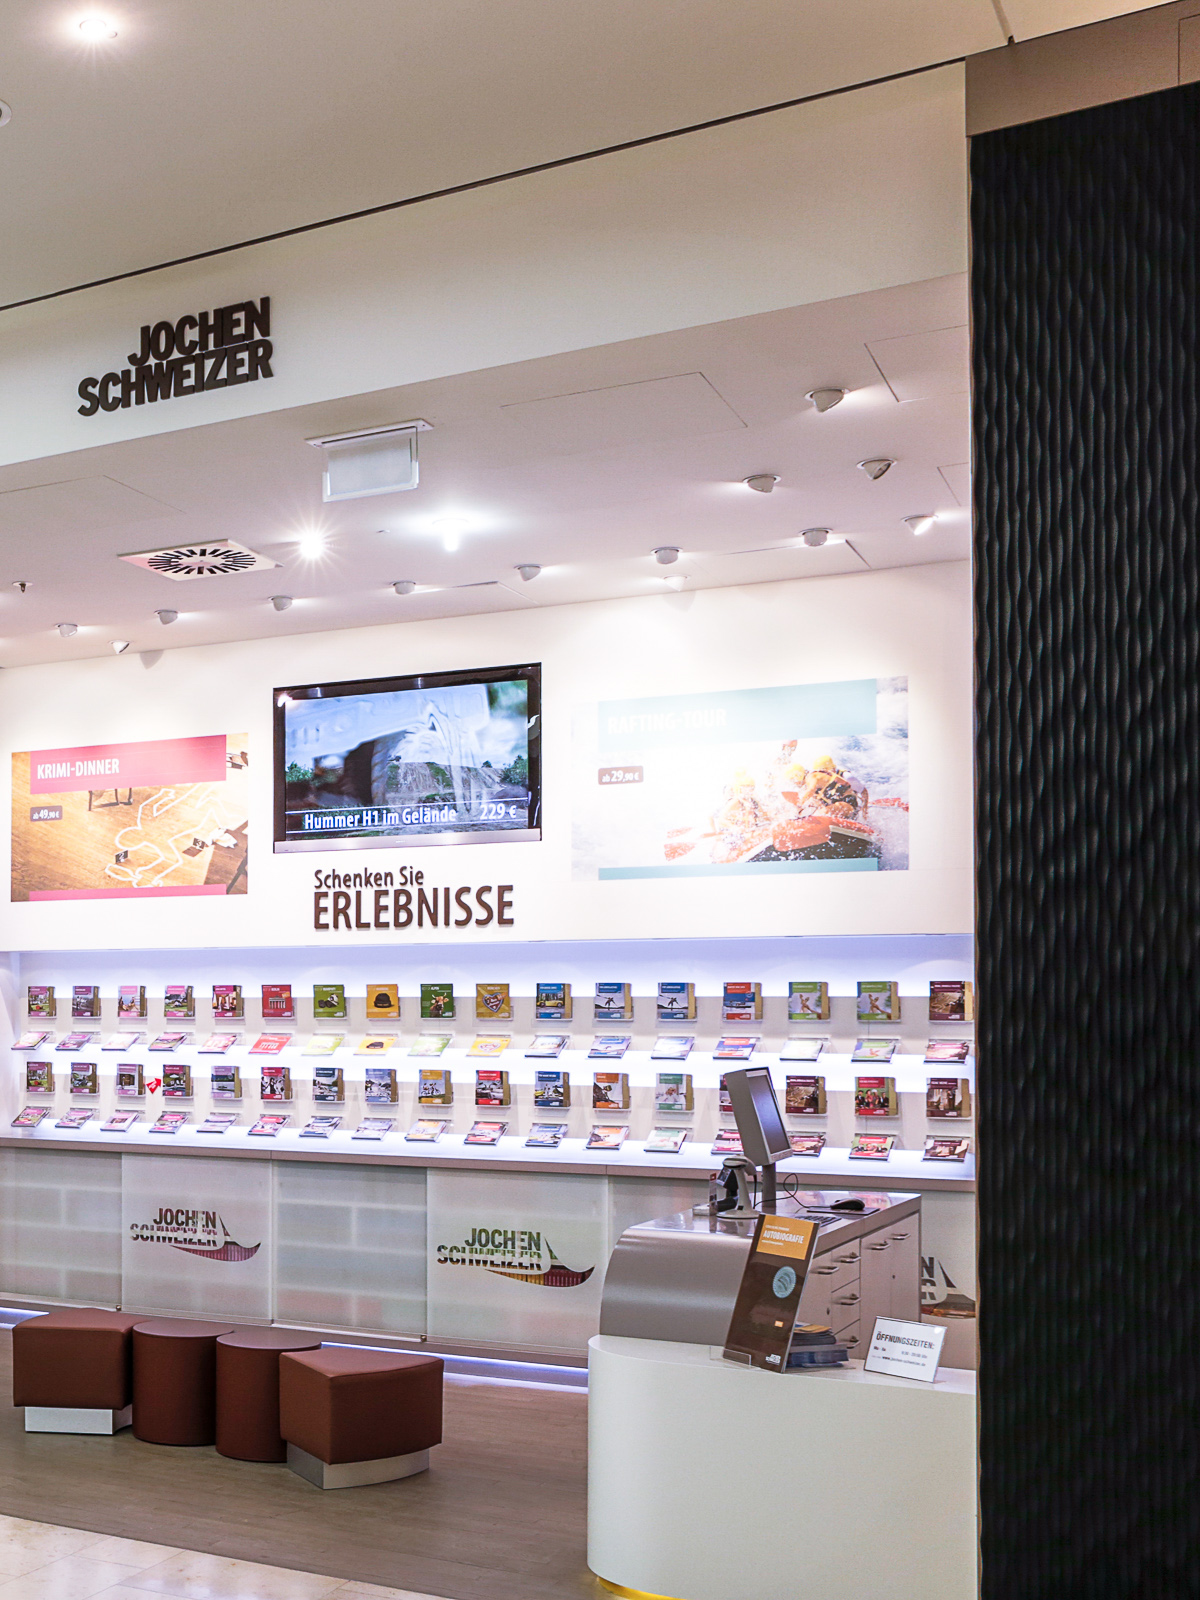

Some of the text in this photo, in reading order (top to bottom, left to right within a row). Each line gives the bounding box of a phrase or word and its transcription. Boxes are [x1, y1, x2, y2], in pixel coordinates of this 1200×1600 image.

[127, 296, 270, 367] JOCHEN
[77, 338, 274, 417] SCHWEIZER
[607, 708, 728, 735] RAFTING-TOUR
[37, 758, 120, 780] KRIMI-DINNER
[304, 802, 517, 830] Hummer H1 im Gelände 229 €
[314, 865, 425, 889] Schenken Sie
[314, 884, 514, 930] ERLEBNISSE
[153, 1207, 217, 1229] JOCHEN
[464, 1227, 541, 1251] JOCHEN
[763, 1229, 805, 1244] AUTOBIOGRAFIE
